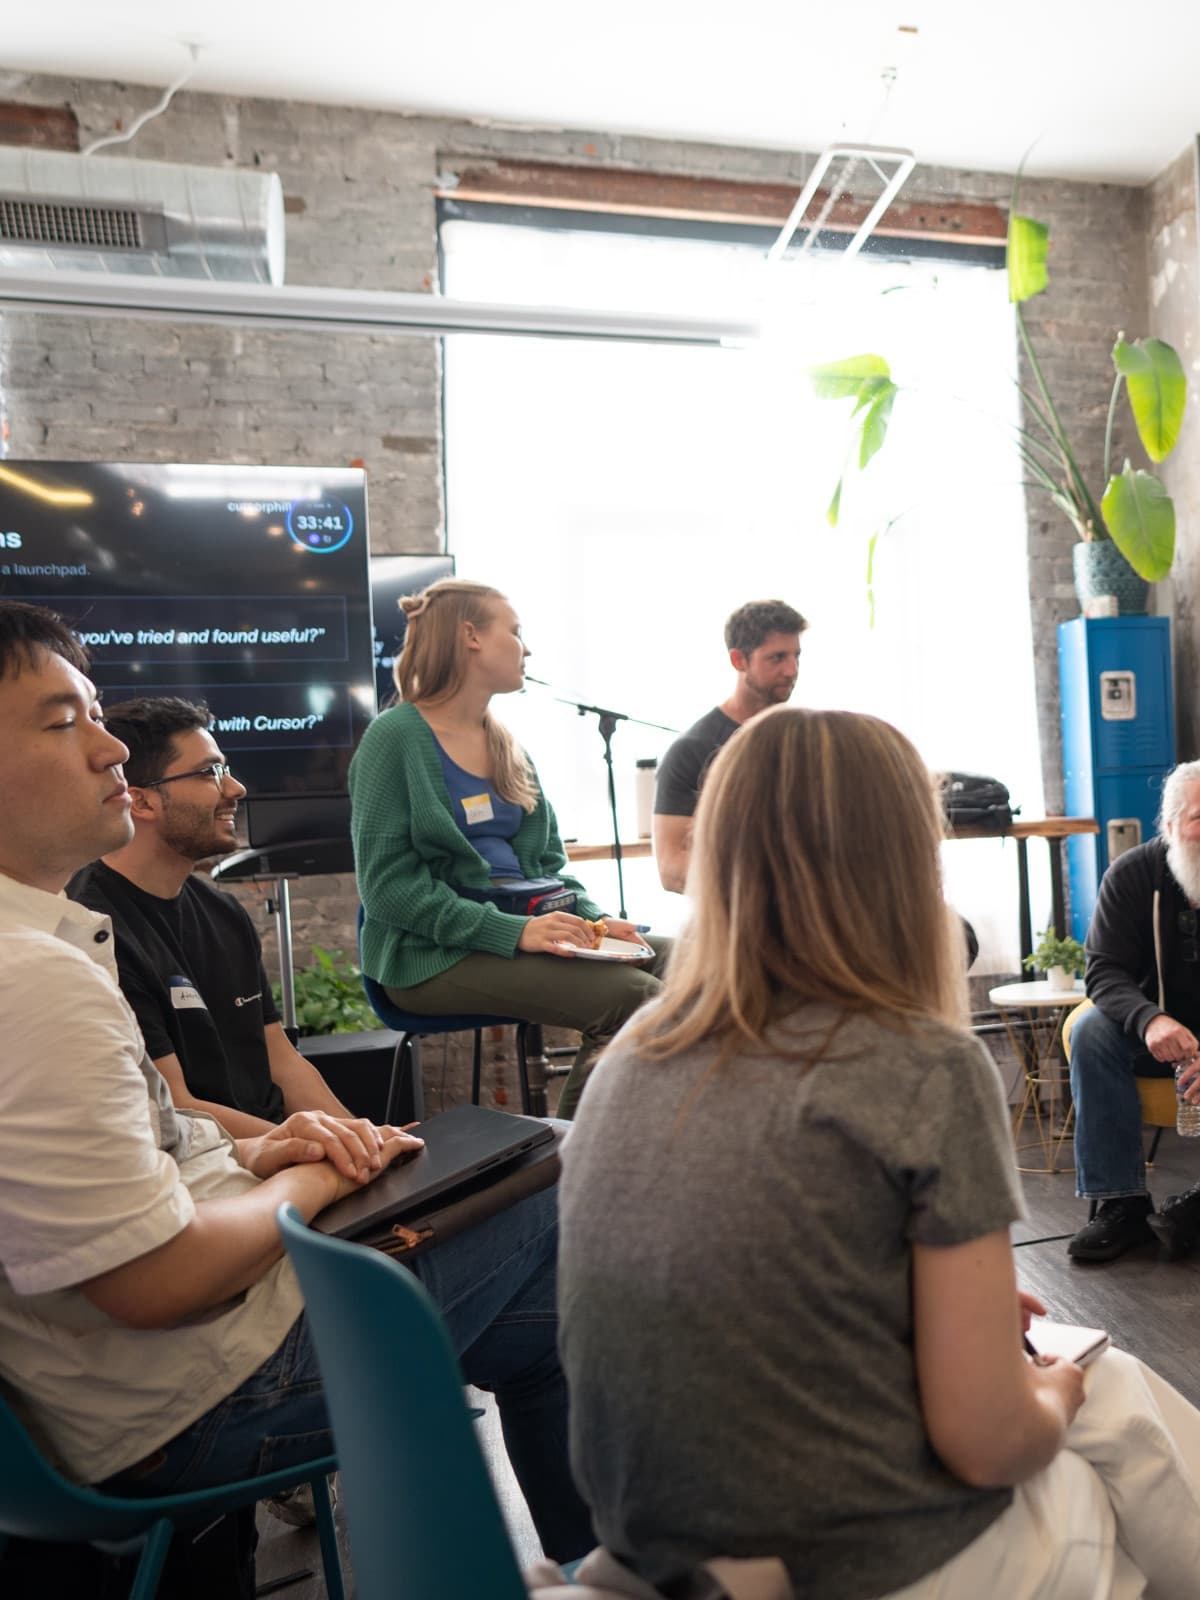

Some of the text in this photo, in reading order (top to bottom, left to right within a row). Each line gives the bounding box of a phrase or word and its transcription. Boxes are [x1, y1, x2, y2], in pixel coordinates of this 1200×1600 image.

[297, 516, 344, 530] 33:41
[2, 562, 91, 579] a launchpad.
[79, 629, 134, 646] you've
[137, 628, 175, 644] tried
[177, 628, 211, 644] and
[211, 628, 260, 644] found
[260, 628, 326, 644] useful?"
[218, 716, 251, 732] with
[253, 715, 325, 731] Cursor?"
